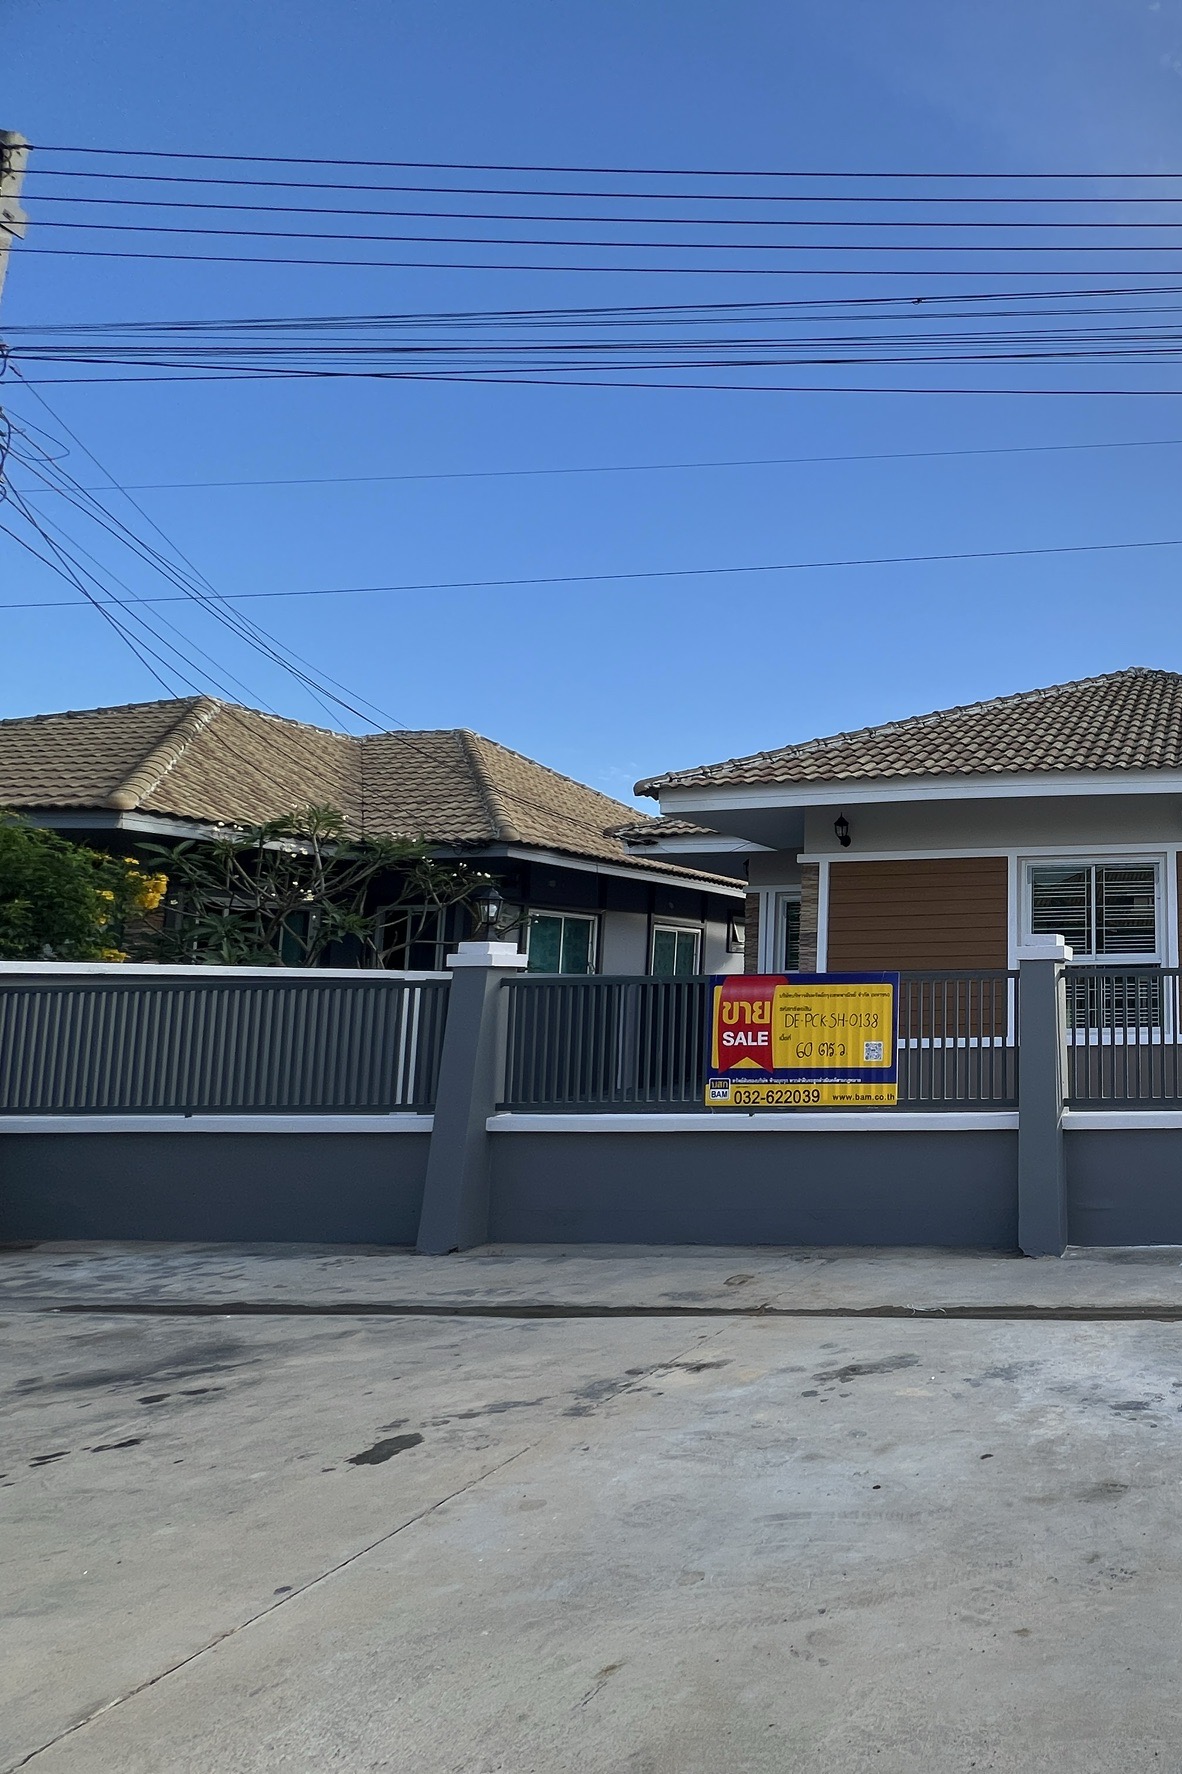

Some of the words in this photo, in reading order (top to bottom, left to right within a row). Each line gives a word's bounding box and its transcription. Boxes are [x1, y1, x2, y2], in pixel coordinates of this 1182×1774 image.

[722, 1001, 771, 1025] ขาย
[784, 1013, 879, 1029] DE-PCK-SH-0138
[722, 1031, 769, 1046] SALE
[796, 1042, 813, 1059] 60
[711, 1090, 728, 1098] BAM
[734, 1089, 821, 1105] 032-622039
[832, 1093, 895, 1101] www.bam.co.th
